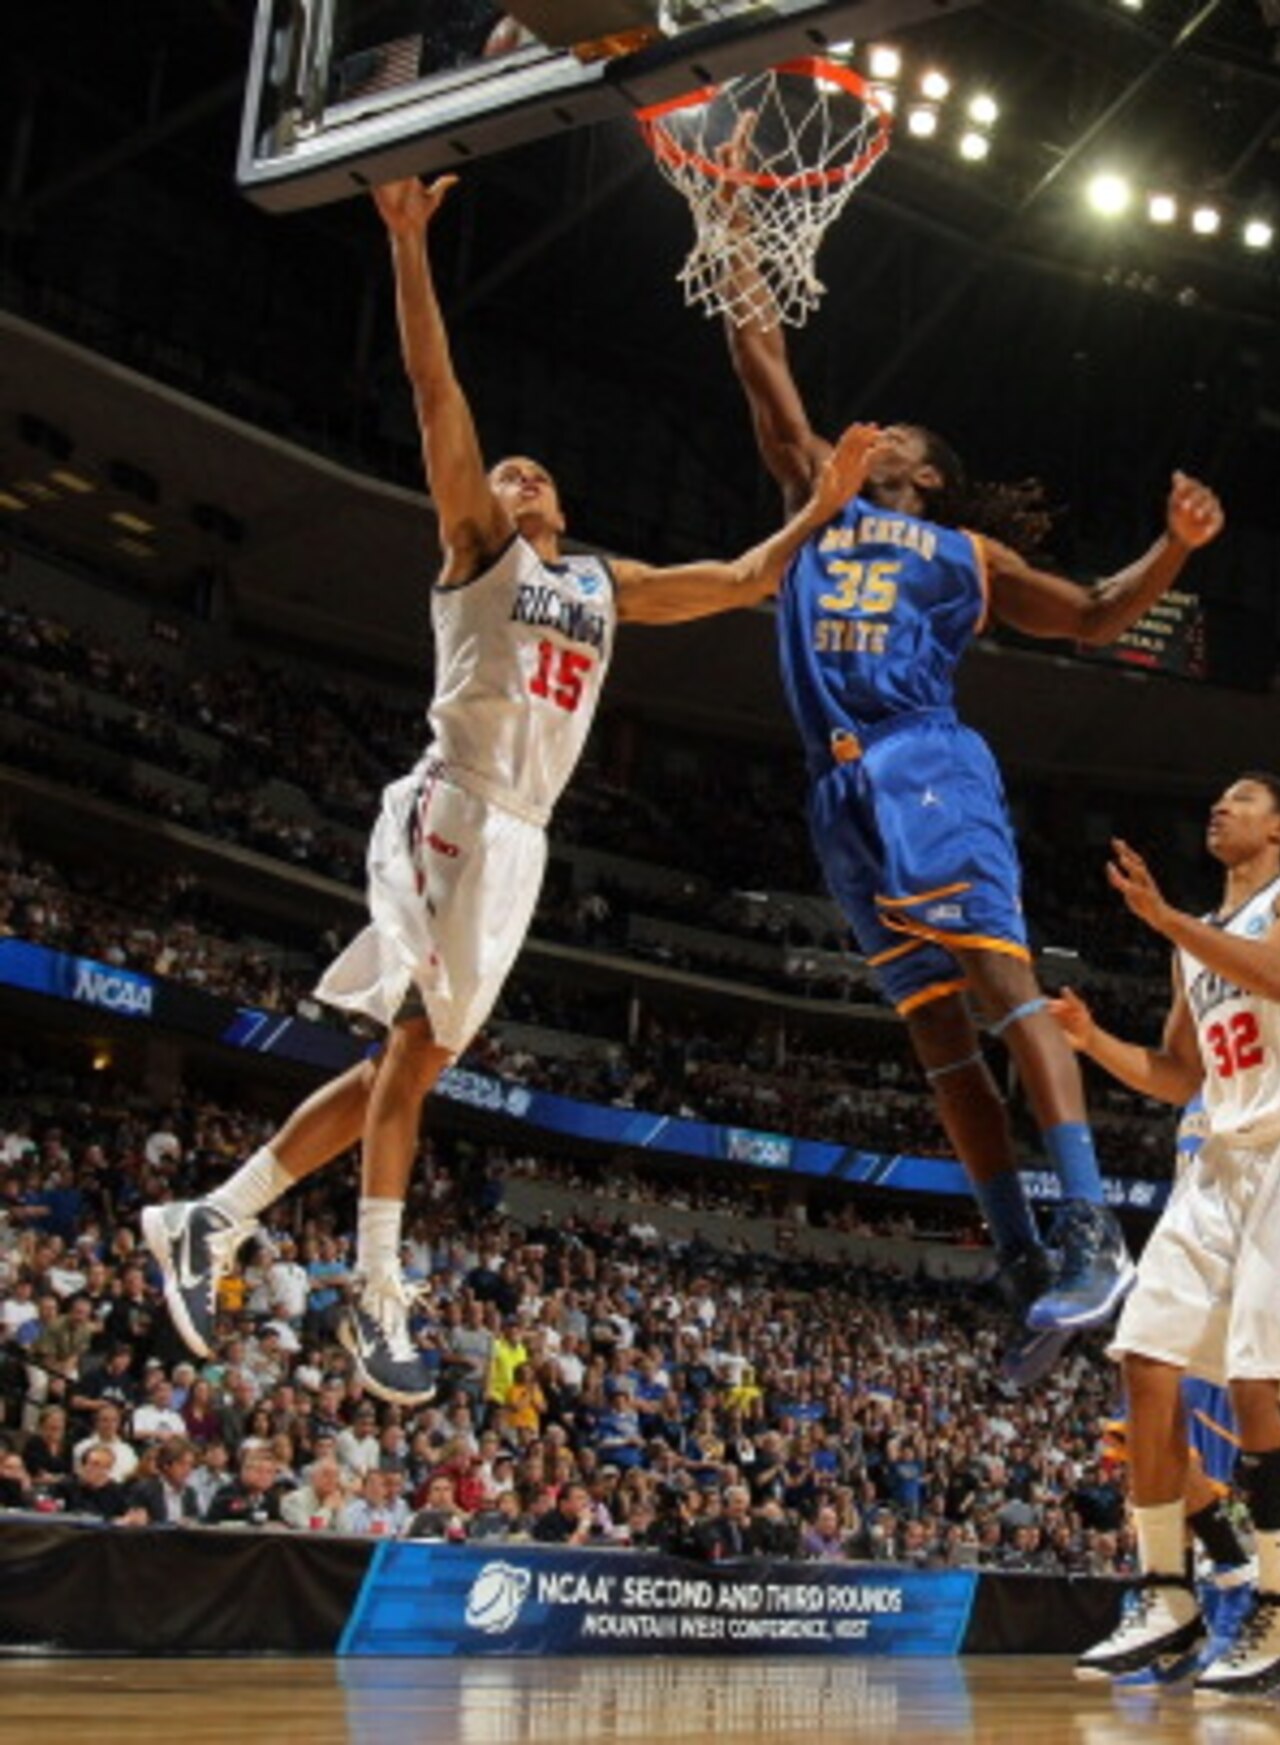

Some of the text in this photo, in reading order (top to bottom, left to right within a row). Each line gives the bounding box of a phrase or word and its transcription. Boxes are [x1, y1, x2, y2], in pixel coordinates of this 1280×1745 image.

[819, 560, 901, 613] 35
[815, 620, 890, 654] STATE
[530, 638, 592, 714] 15
[73, 967, 152, 1017] NCAA
[1207, 1011, 1264, 1079] 32
[727, 1134, 790, 1168] NCAA
[537, 1573, 902, 1613] NCAA SECOND AND THIRD ROUNDS
[582, 1614, 677, 1638] MOUNTAIN
[680, 1616, 725, 1638] WEST
